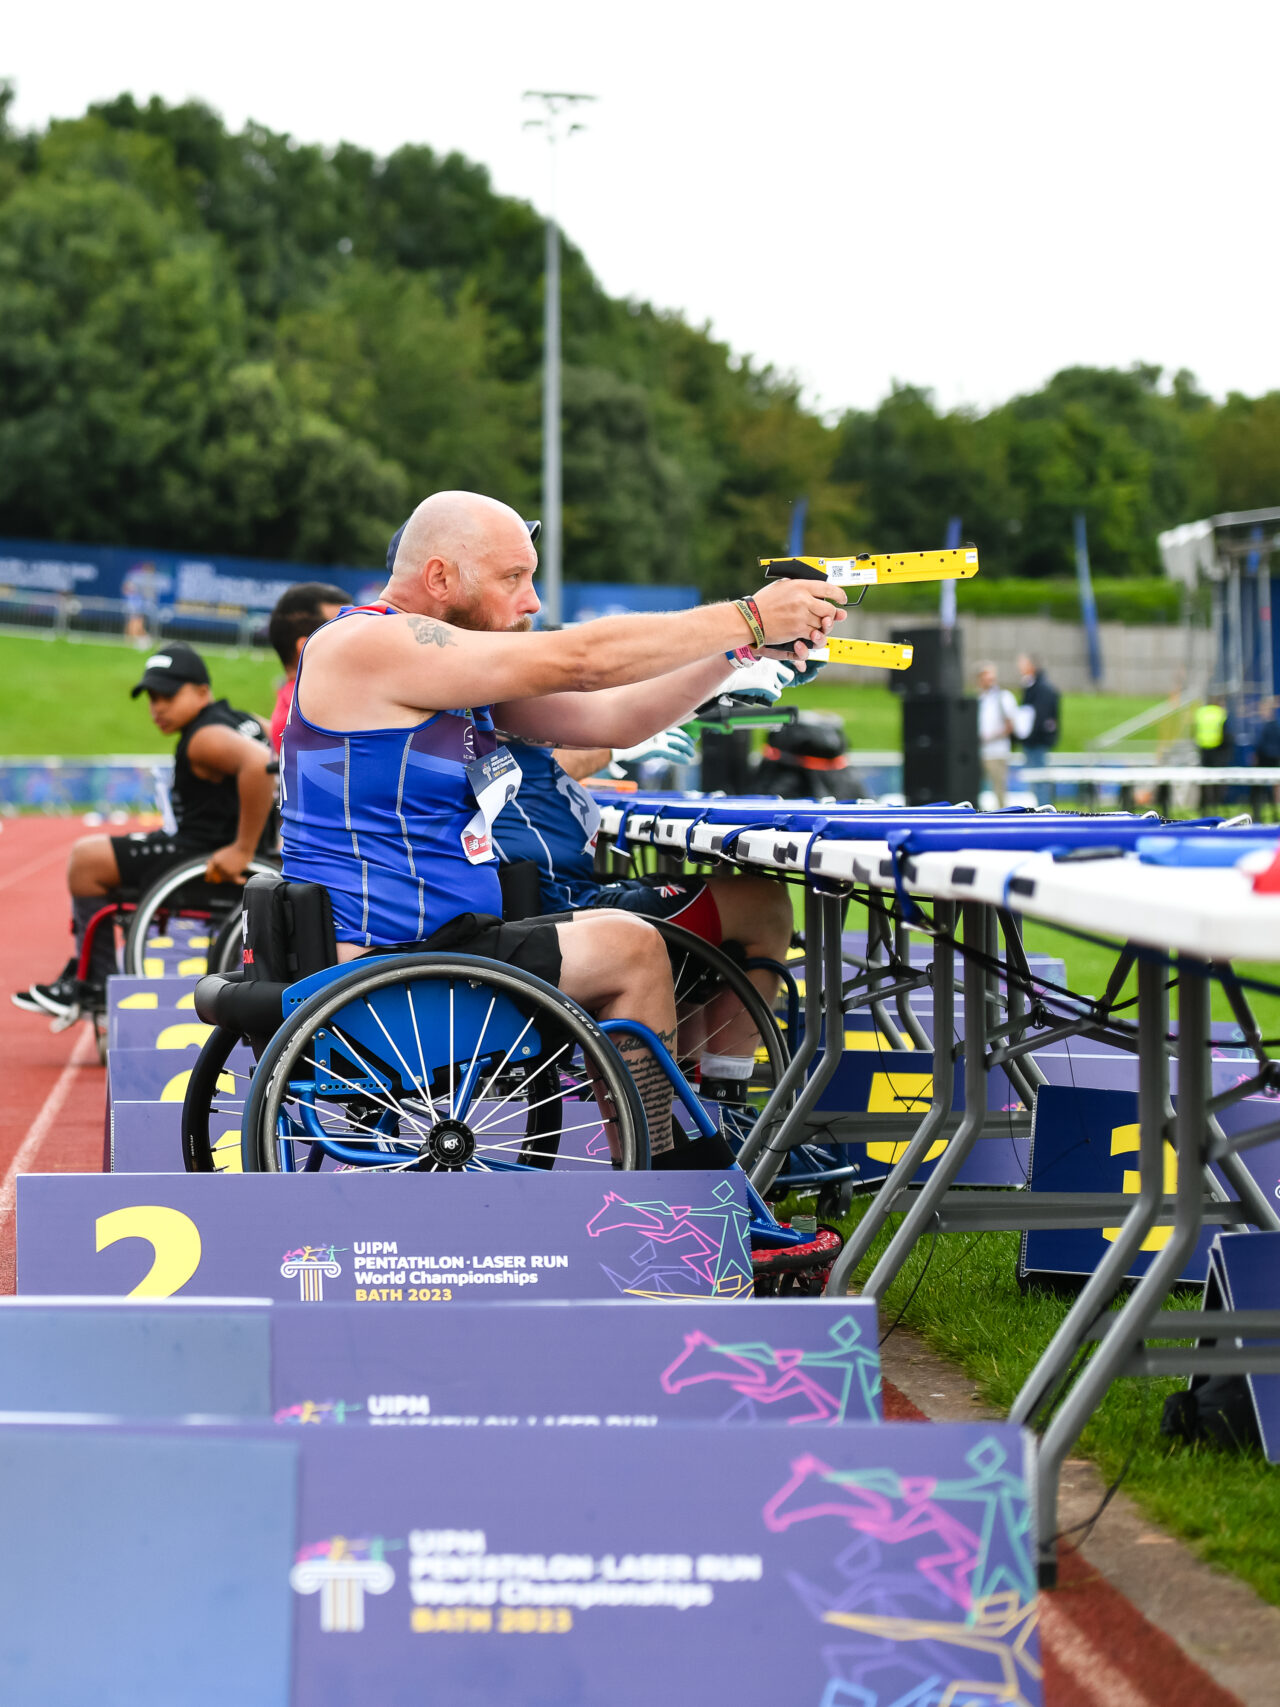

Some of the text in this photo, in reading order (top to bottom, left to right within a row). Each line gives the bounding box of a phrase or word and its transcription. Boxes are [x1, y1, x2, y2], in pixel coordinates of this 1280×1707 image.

[564, 1000, 601, 1037] KENDA
[95, 1206, 202, 1296] 2
[354, 1242, 398, 1254] UIPM
[531, 1255, 569, 1268] RUN
[354, 1271, 539, 1286] World Championships
[355, 1288, 452, 1301] BATH 2023
[367, 1395, 431, 1416] UIPM
[409, 1529, 487, 1554] UIPM
[696, 1554, 764, 1582] RUN
[410, 1581, 715, 1611] World Championships
[411, 1606, 573, 1633] BATH 2023
